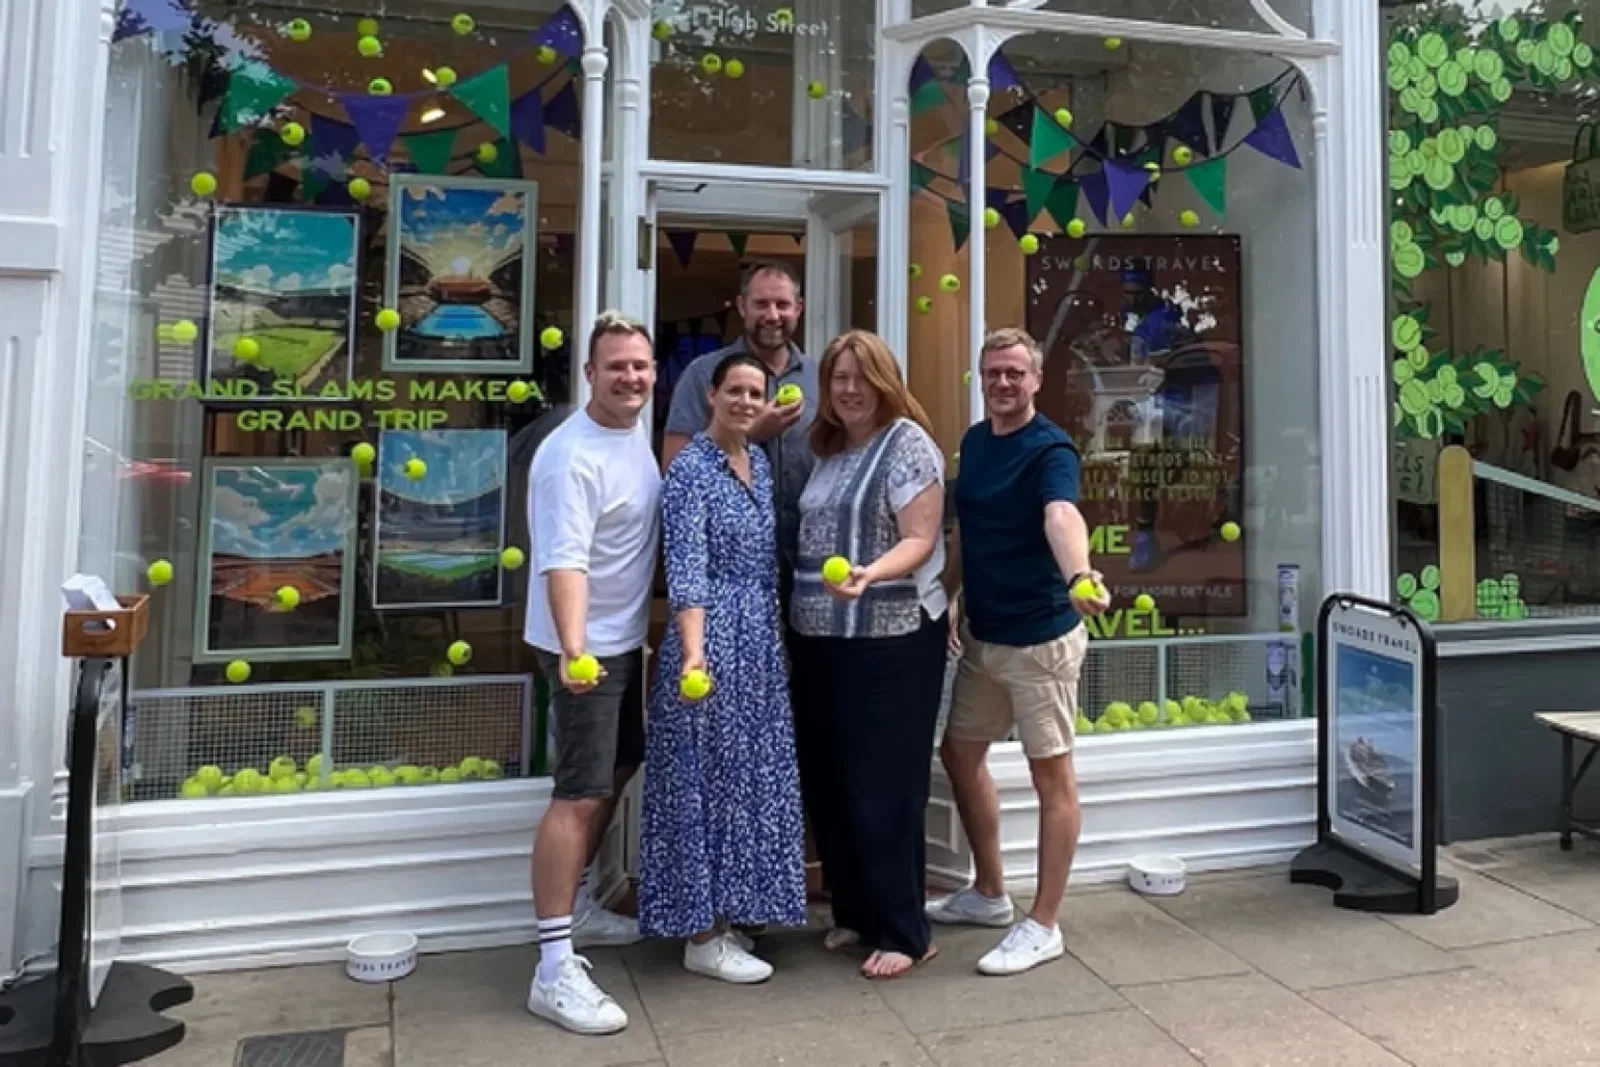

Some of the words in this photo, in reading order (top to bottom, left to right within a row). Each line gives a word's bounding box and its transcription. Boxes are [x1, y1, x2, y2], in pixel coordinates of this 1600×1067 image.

[709, 8, 758, 35] High
[765, 12, 829, 37] Street
[1042, 255, 1136, 271] SWRDS
[130, 378, 260, 400] GRAND
[272, 378, 396, 400] SLAMS
[410, 379, 508, 401] MAKE
[525, 379, 545, 401] A
[236, 409, 362, 432] GRAND
[373, 409, 449, 431] TRIP
